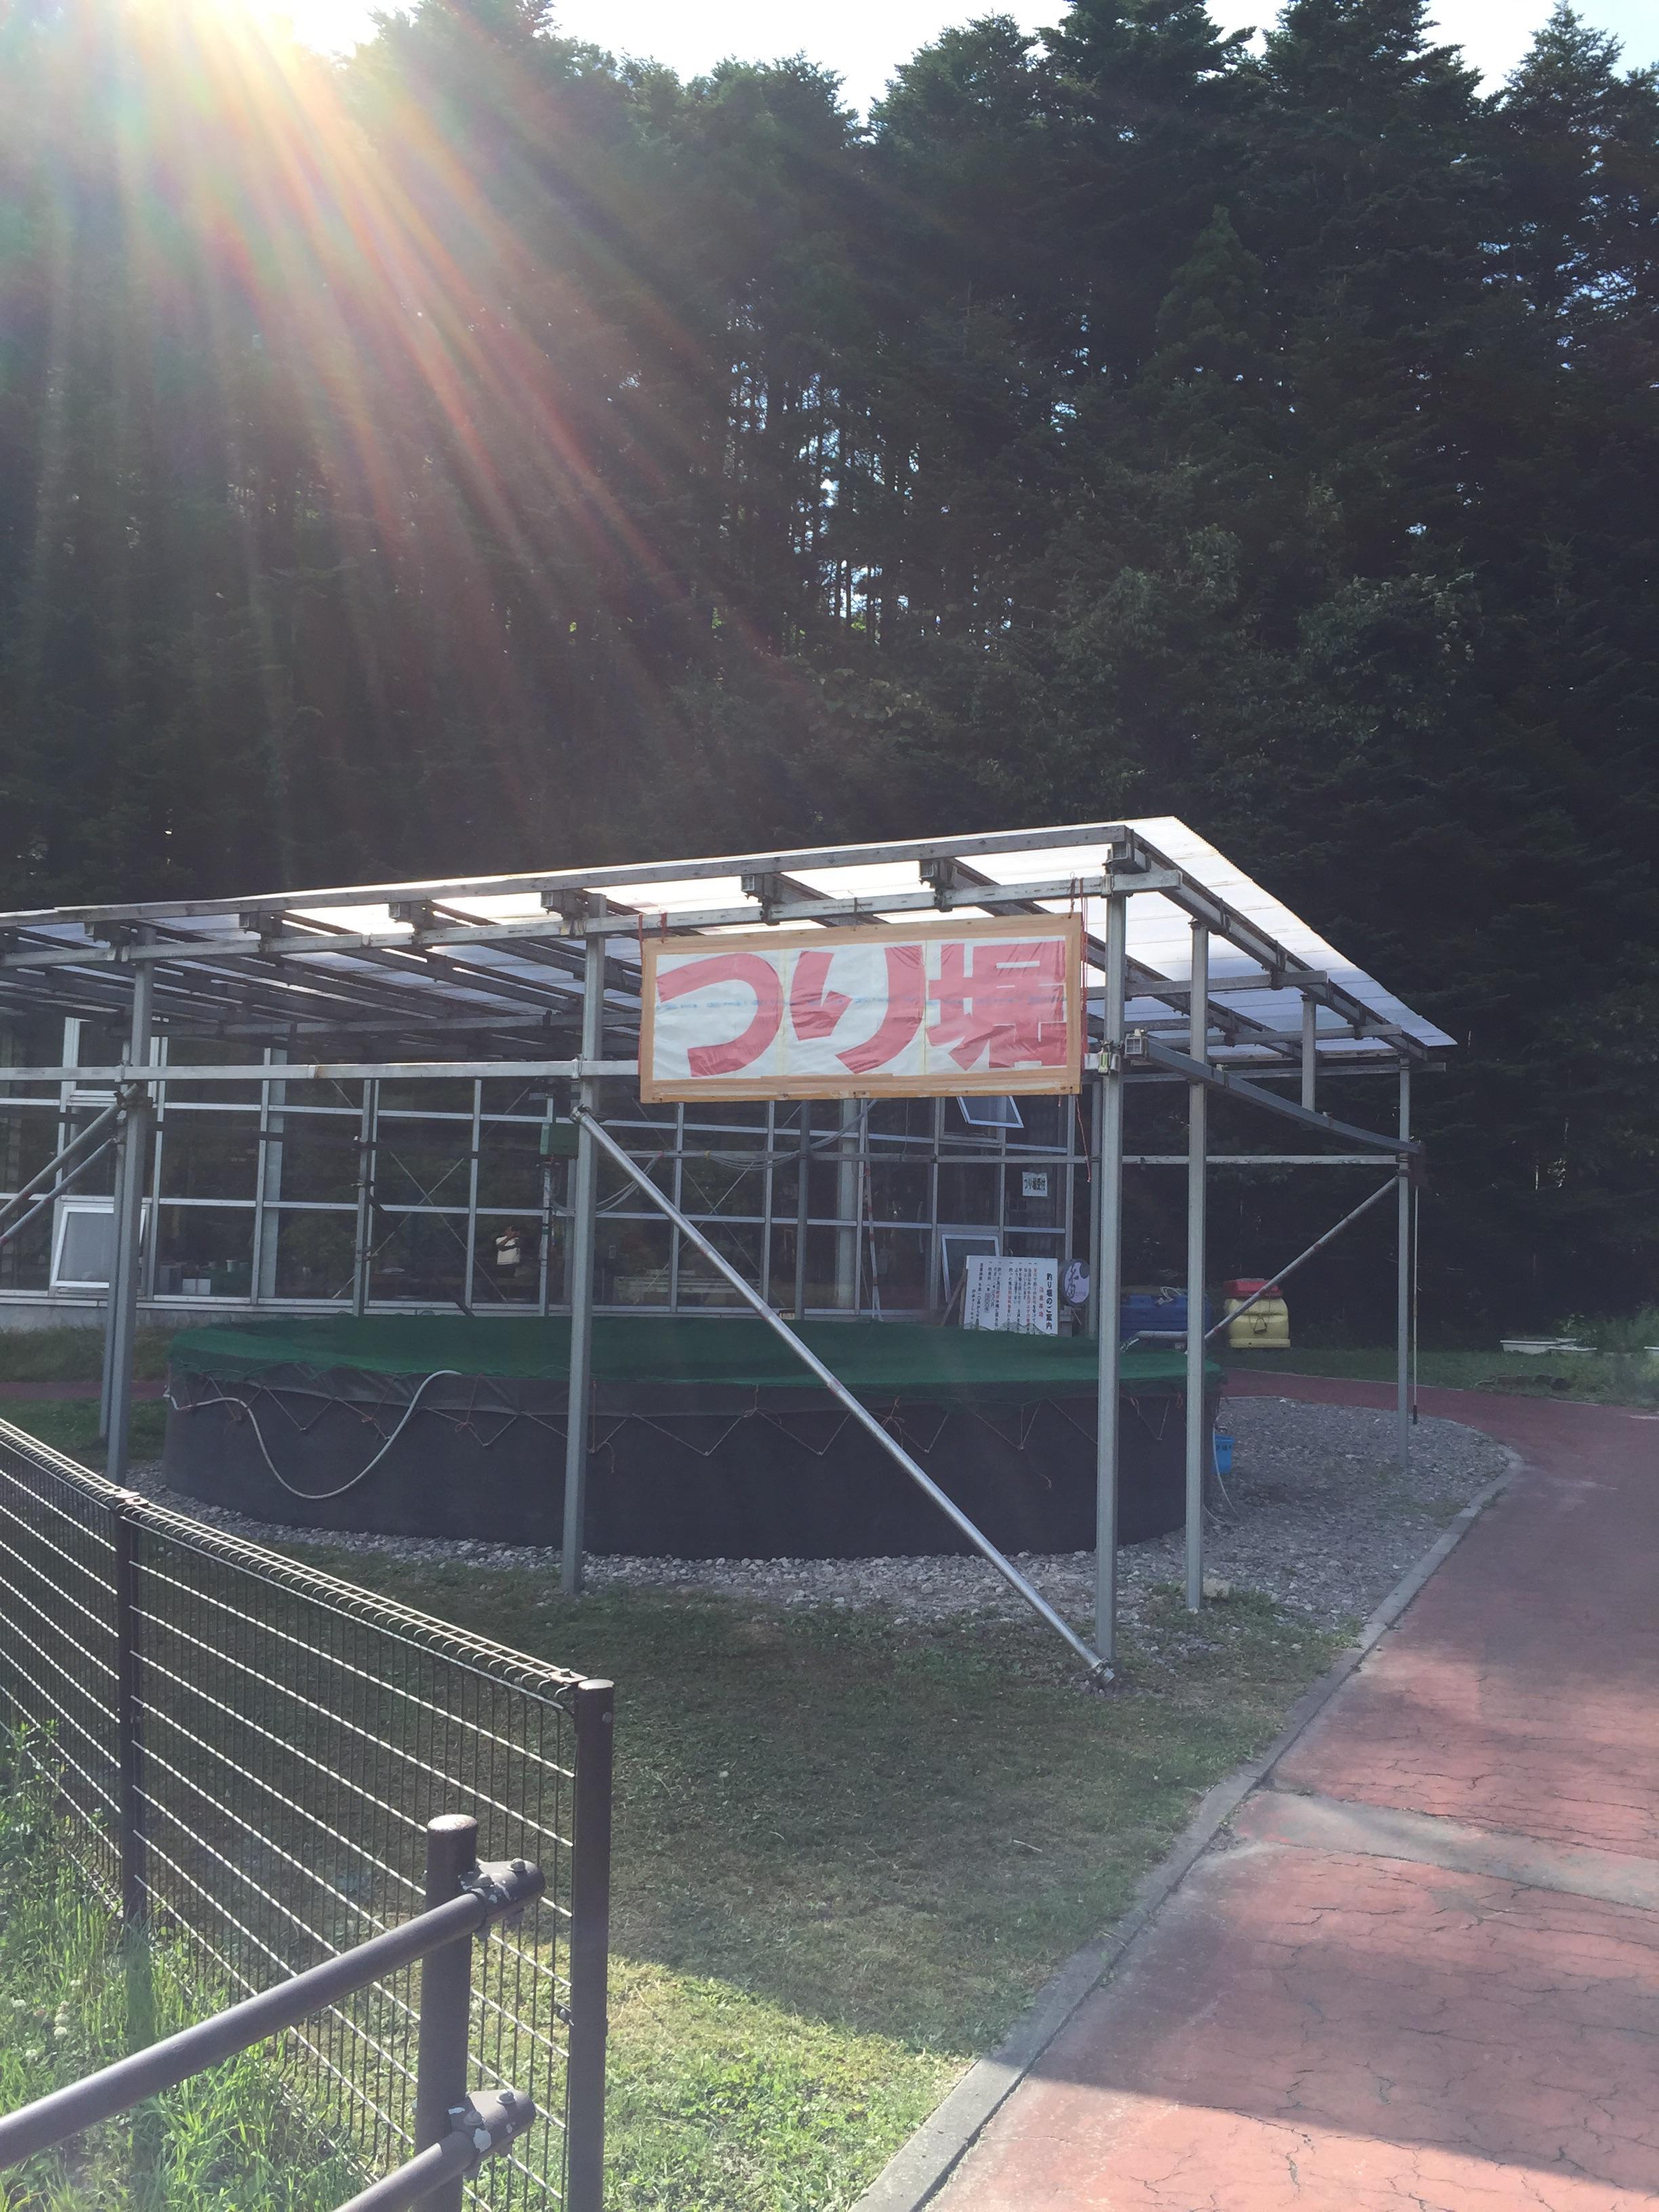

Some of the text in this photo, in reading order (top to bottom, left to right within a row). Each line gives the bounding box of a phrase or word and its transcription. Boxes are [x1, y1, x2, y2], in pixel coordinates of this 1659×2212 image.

[655, 939, 1067, 1077] つり堀
[1024, 1177, 1046, 1191] つり堀受付
